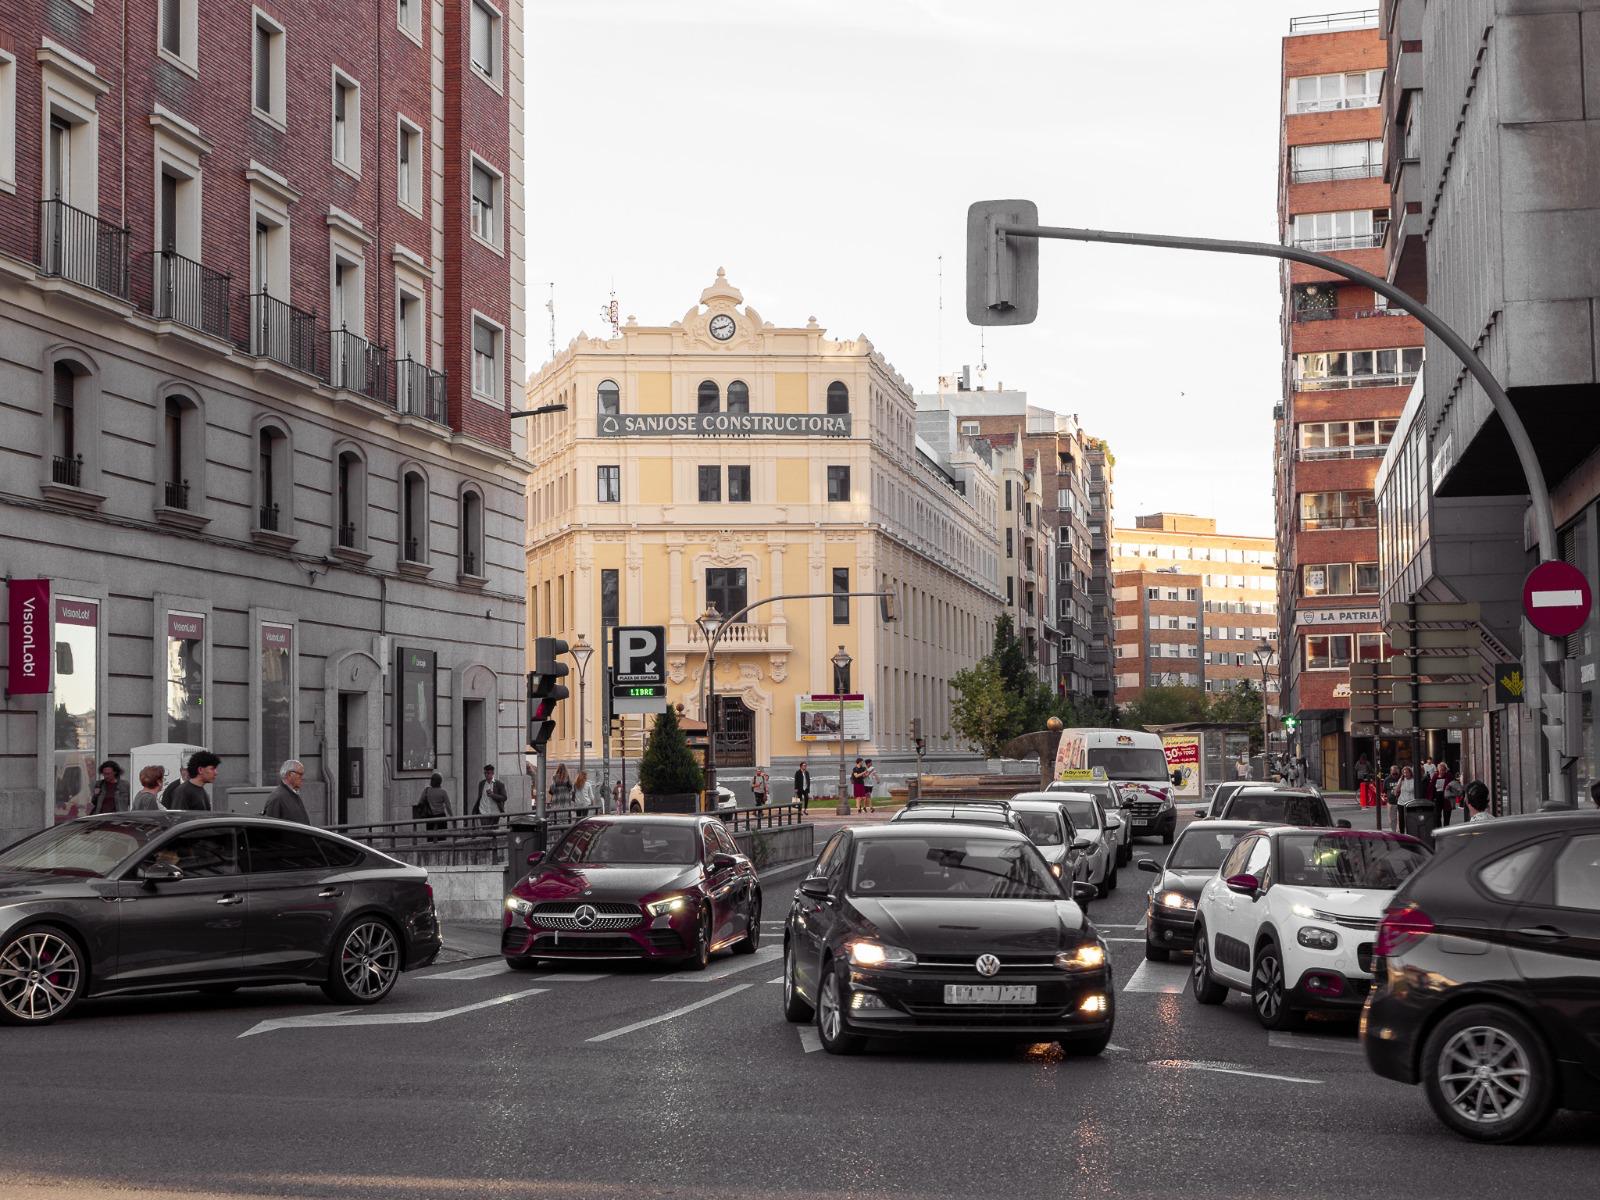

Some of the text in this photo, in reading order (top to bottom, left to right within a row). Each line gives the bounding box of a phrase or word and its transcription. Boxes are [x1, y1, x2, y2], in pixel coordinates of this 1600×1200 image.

[624, 415, 847, 431] SANJOSE CONSTRUCTORA
[62, 607, 90, 620] VisionLab!
[1320, 612, 1335, 621] LA
[1339, 611, 1378, 620] PATRIA
[23, 596, 36, 677] VisionLab!
[619, 630, 657, 673] P
[630, 688, 654, 696] LIBRE
